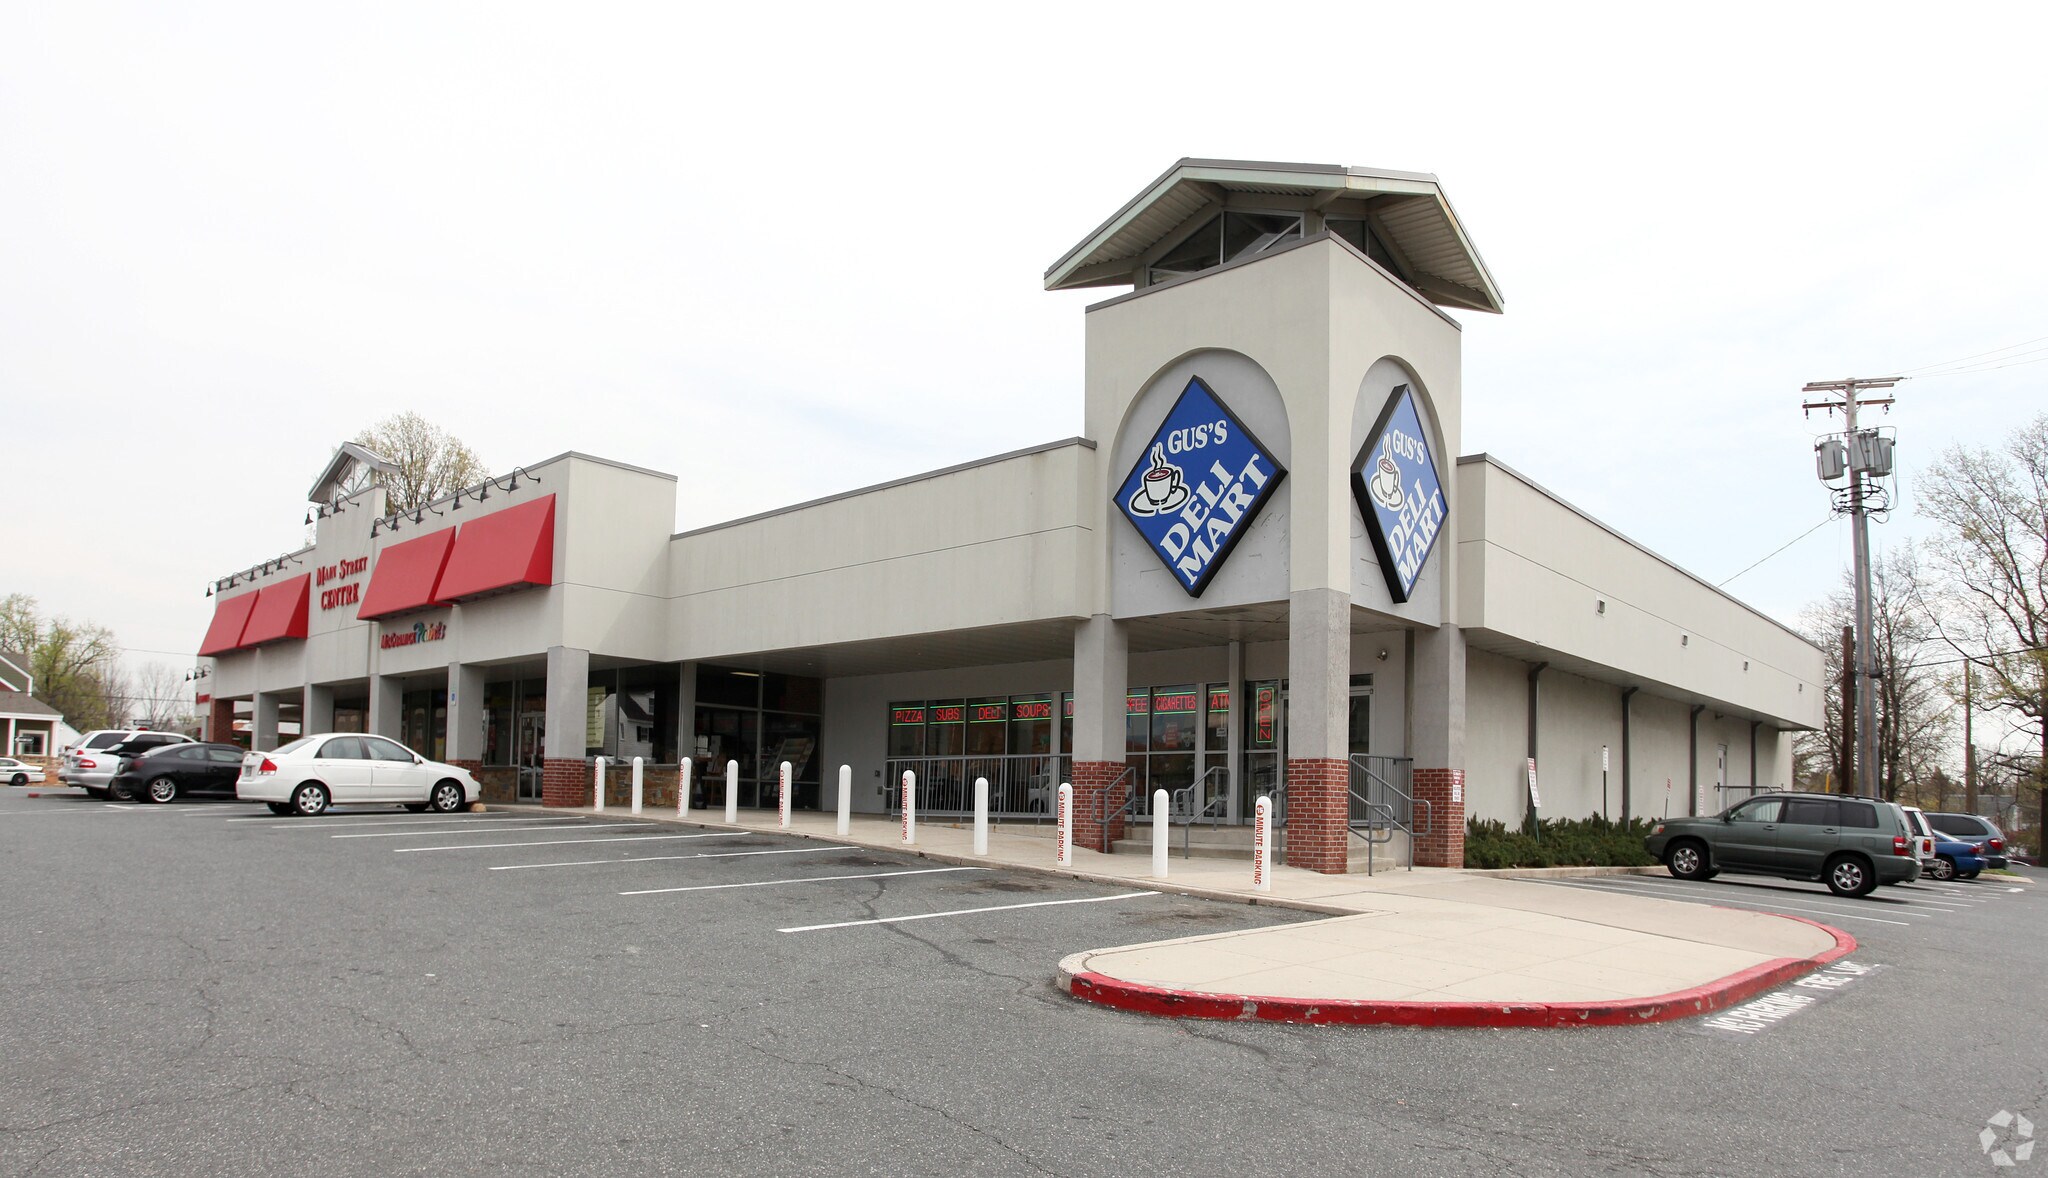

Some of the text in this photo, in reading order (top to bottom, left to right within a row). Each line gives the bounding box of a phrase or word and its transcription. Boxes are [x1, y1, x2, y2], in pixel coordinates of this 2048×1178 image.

[1167, 419, 1228, 455] GUS'S
[1392, 428, 1425, 466] GUS'S
[1160, 459, 1234, 562] DELI
[1176, 453, 1269, 586] MART
[1388, 478, 1429, 564] DELI
[1396, 486, 1441, 591] MART
[317, 556, 368, 587] MAIN STREET
[321, 582, 359, 611] CENTRE
[896, 710, 923, 722] PIZZA
[936, 708, 960, 721] SUBS
[978, 706, 1001, 720] DELI
[1016, 703, 1049, 718] SOUPS
[1156, 695, 1196, 711] CIGARETTES
[1259, 690, 1272, 740] OPEN
[1057, 831, 1065, 862] PARKING
[1255, 817, 1264, 847] MINUTE
[1254, 849, 1263, 885] PARKING
